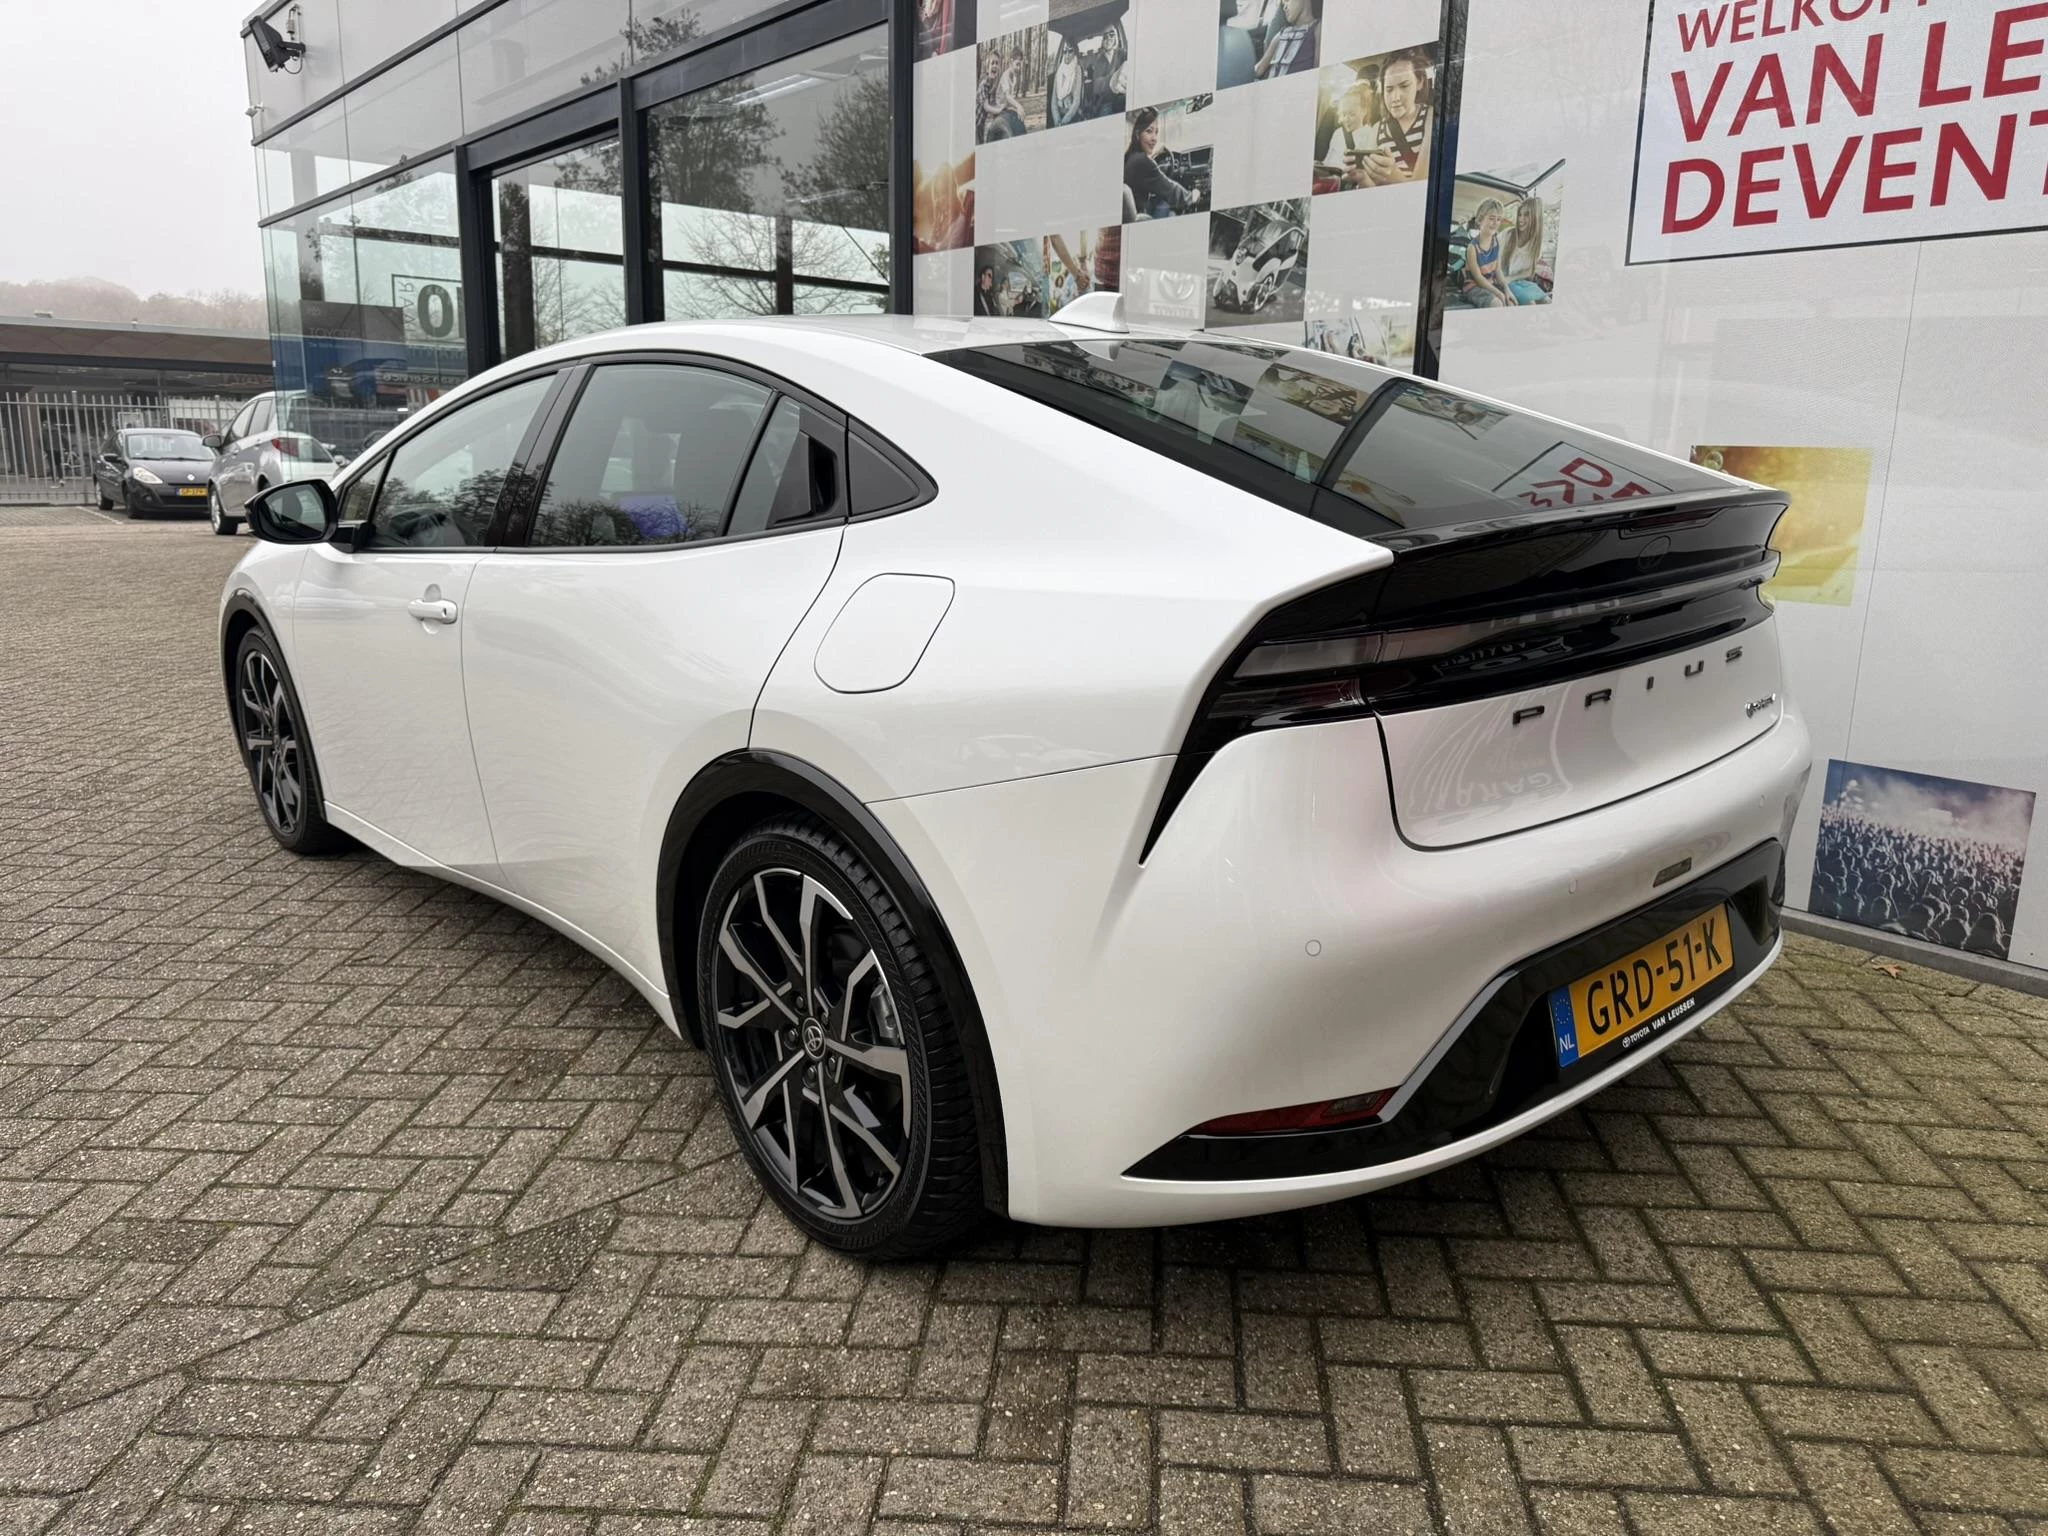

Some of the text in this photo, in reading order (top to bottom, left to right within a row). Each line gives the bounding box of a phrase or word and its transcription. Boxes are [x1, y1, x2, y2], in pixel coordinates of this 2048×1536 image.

[1677, 0, 1927, 53] WELKO
[1671, 2, 2048, 143] VAN LE
[1512, 646, 1743, 726] PRIUS
[1586, 917, 1722, 1036] GRD-51-K
[1558, 1034, 1575, 1053] NL
[1629, 1026, 1650, 1043] TOYOTA
[1651, 1015, 1666, 1030] VAN
